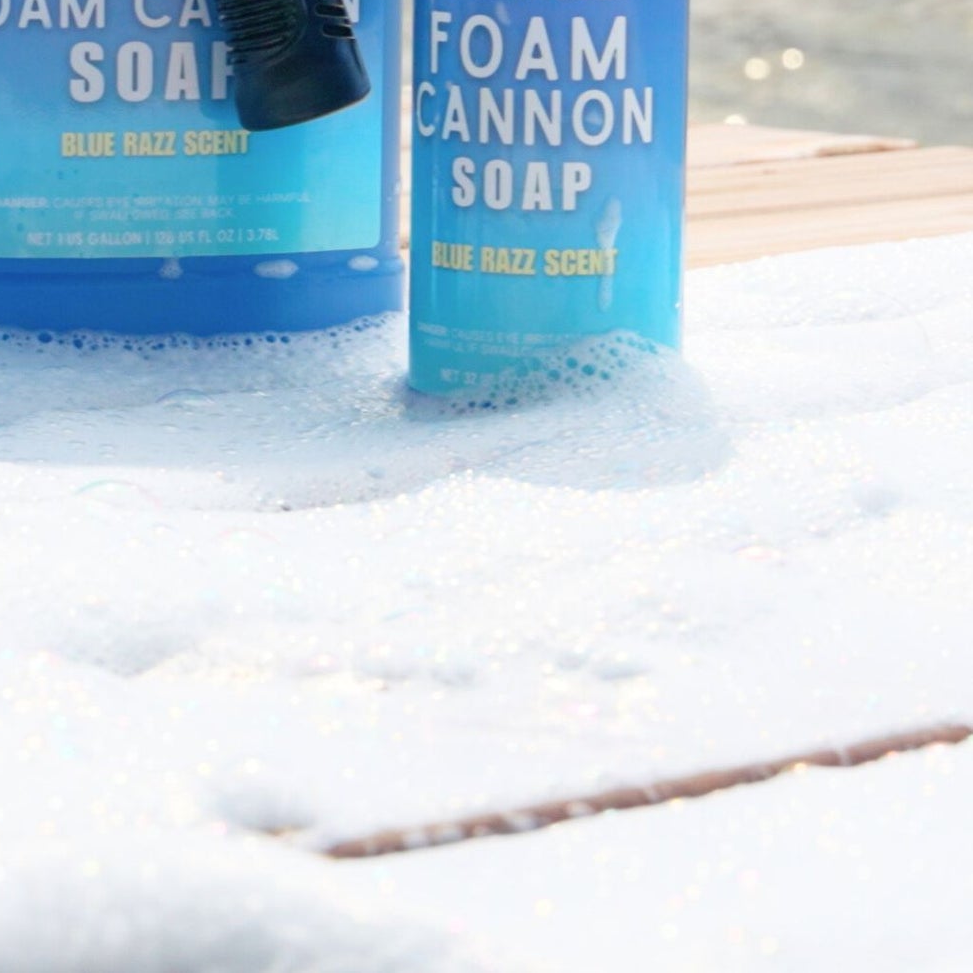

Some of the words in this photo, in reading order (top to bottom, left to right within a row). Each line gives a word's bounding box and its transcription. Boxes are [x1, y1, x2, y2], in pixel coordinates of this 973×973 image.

[431, 11, 627, 81] FOAM
[416, 81, 653, 146] CANNON
[61, 132, 115, 157] BLUE
[123, 132, 175, 156] RAZZ
[183, 130, 249, 155] SCENT
[451, 157, 593, 211] SOAP
[26, 232, 52, 246] NET
[87, 231, 141, 245] GALLON
[198, 230, 212, 244] FL
[217, 228, 235, 242] OZ
[431, 240, 474, 271] BLUE
[480, 246, 536, 275] RAZZ
[544, 248, 618, 277] SCENT
